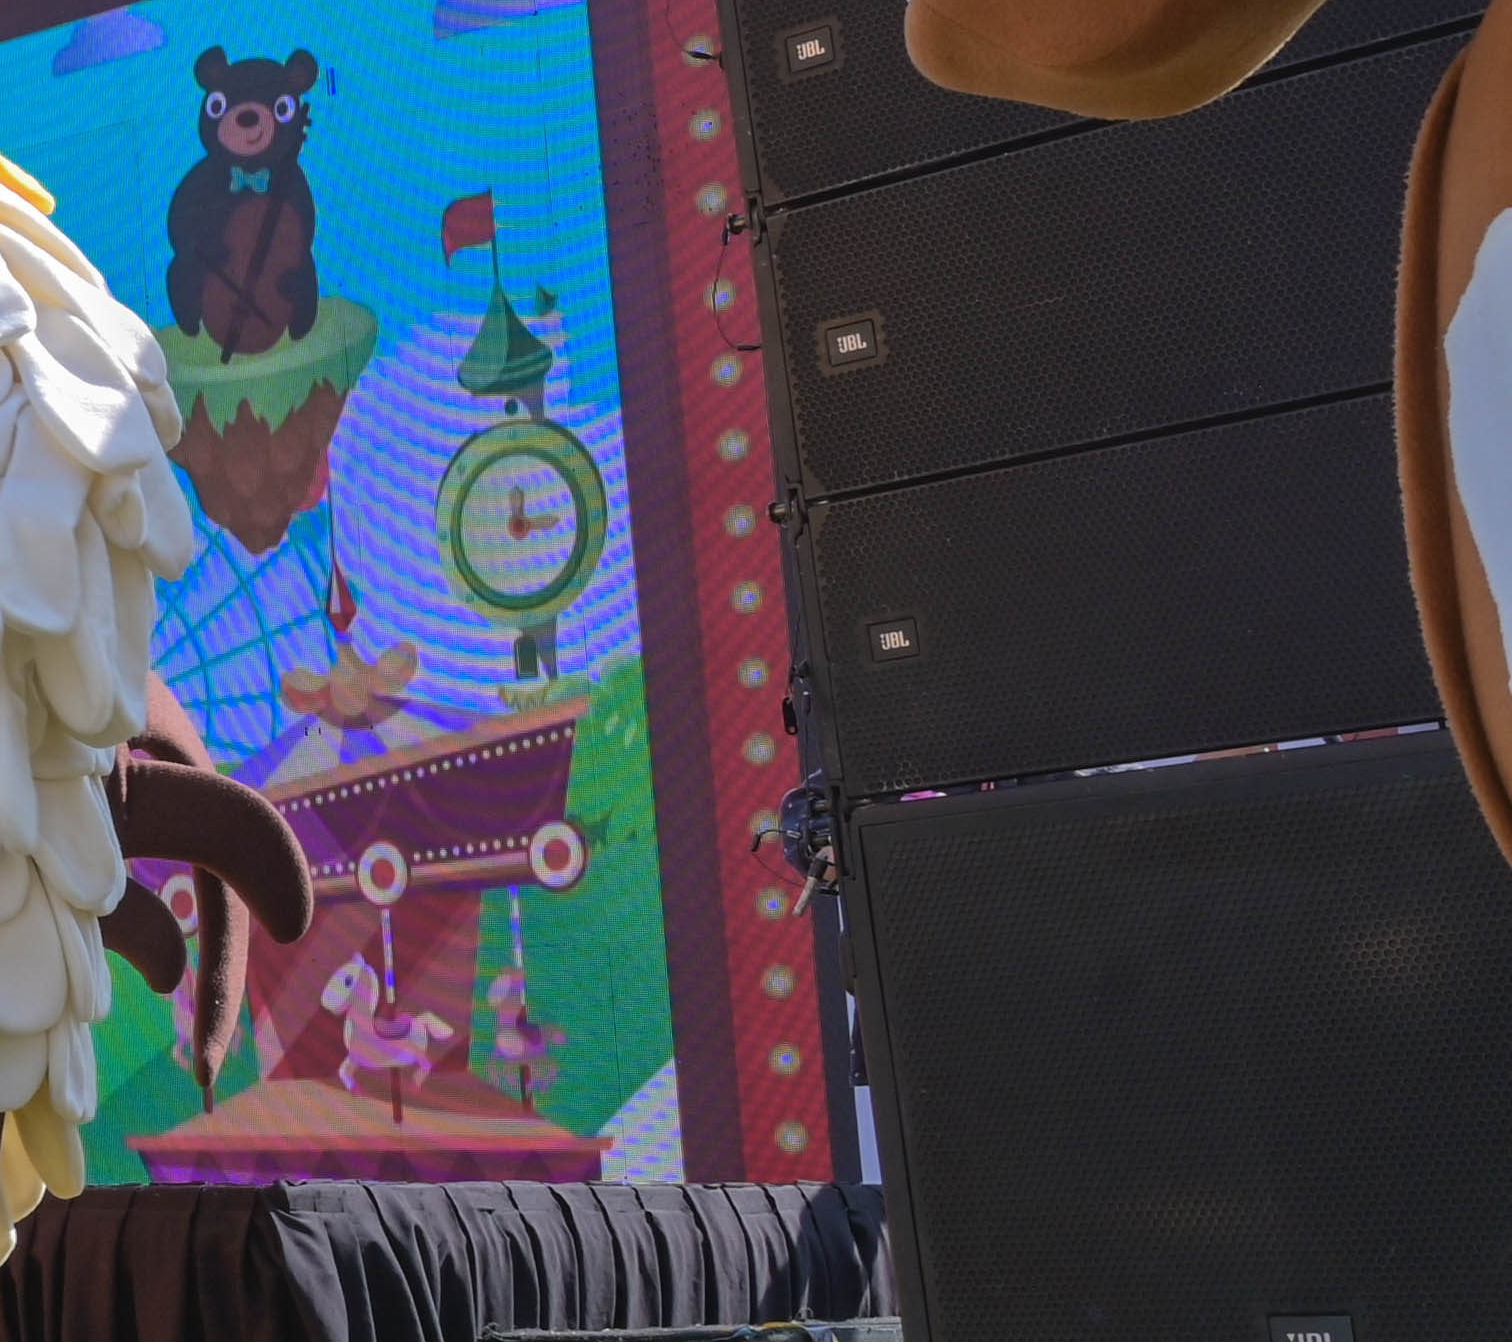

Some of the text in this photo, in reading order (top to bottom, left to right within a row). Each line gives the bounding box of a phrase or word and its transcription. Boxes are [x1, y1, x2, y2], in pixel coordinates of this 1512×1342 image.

[796, 38, 825, 61] JBL
[836, 332, 867, 354] JBL
[879, 630, 910, 651] JBL
